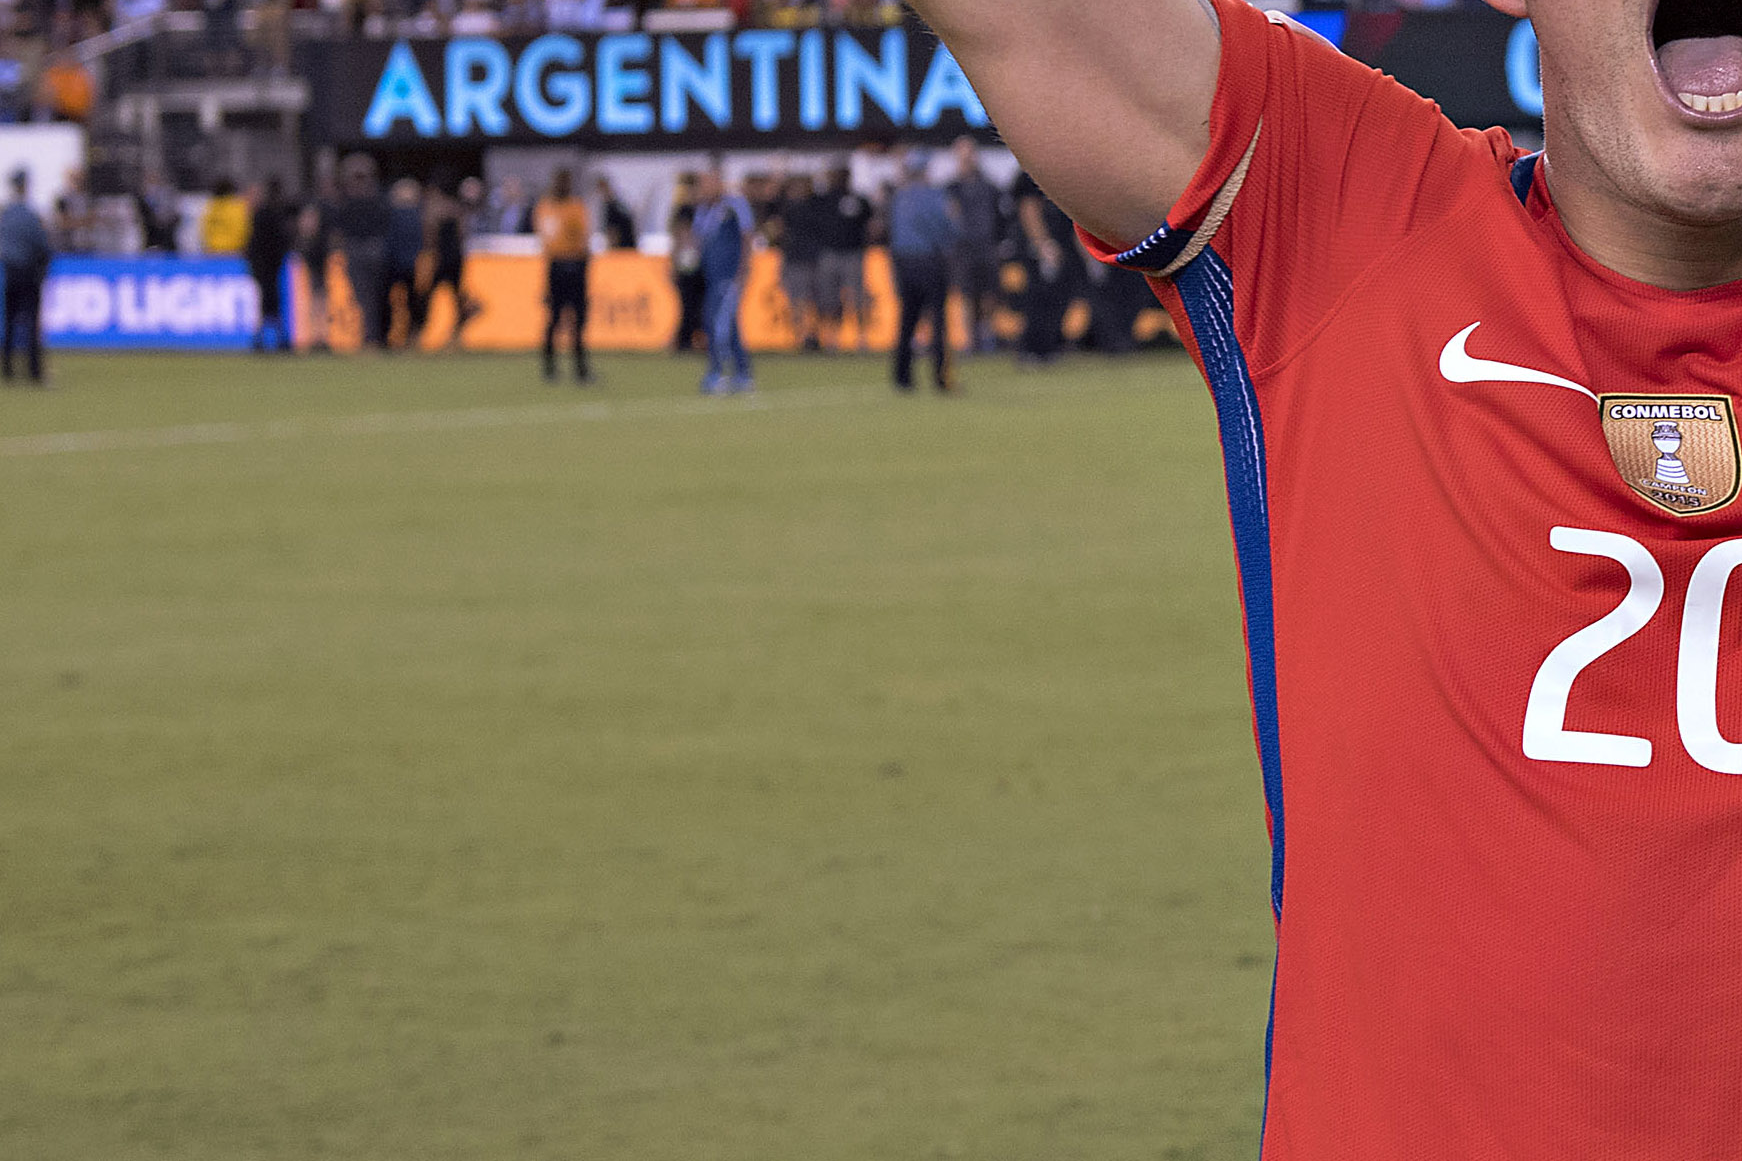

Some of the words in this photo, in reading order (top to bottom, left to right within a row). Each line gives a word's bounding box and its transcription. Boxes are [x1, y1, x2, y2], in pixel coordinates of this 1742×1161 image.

[362, 28, 992, 138] ARGENTINA
[1610, 404, 1723, 422] CONMEBOL
[1652, 489, 1701, 507] 2015
